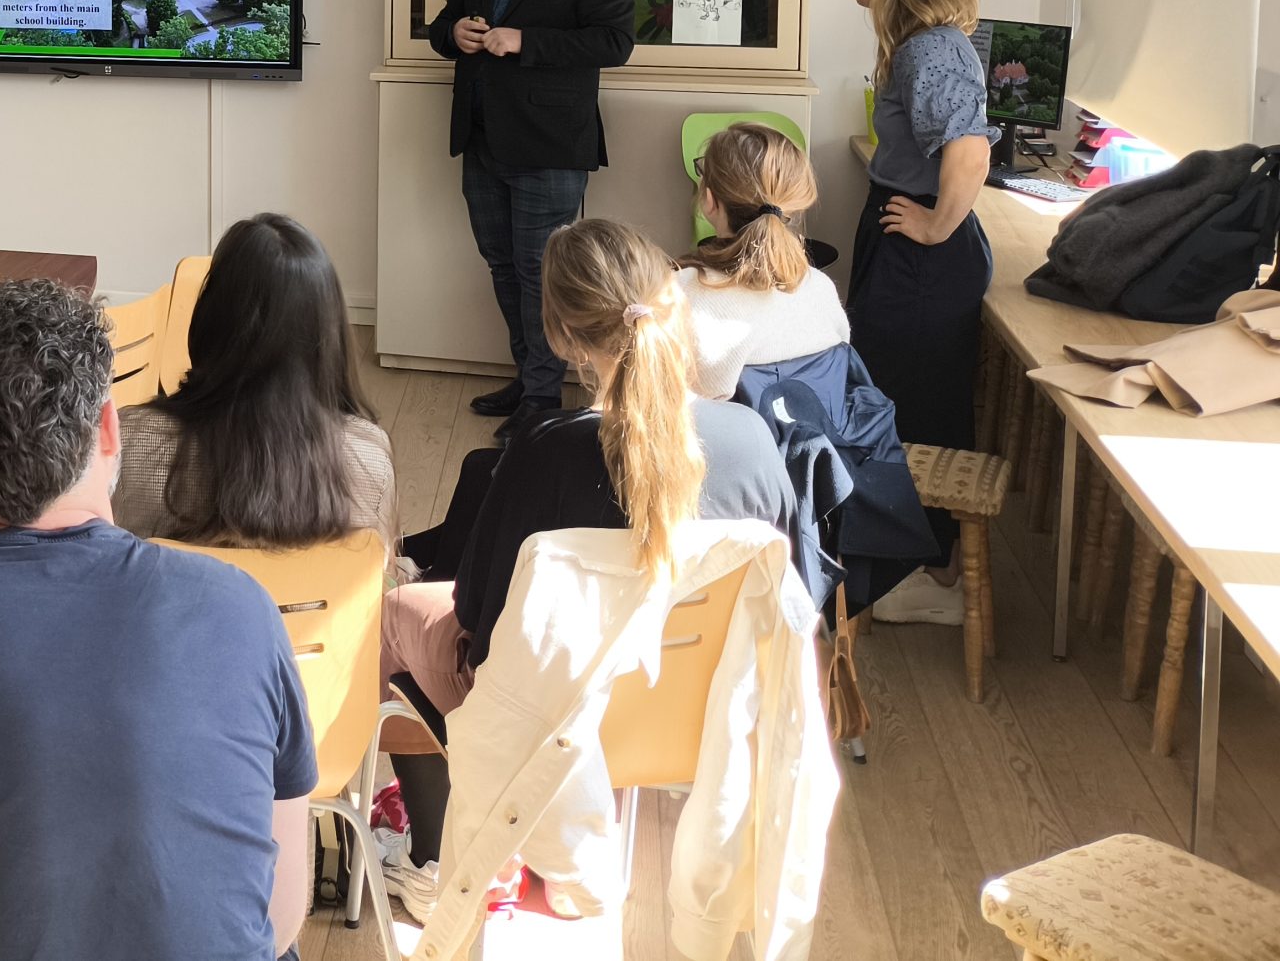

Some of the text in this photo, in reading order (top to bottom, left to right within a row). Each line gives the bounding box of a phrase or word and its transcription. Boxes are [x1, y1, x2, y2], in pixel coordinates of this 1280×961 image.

[3, 3, 99, 13] meters from the main
[16, 16, 86, 27] school building.
